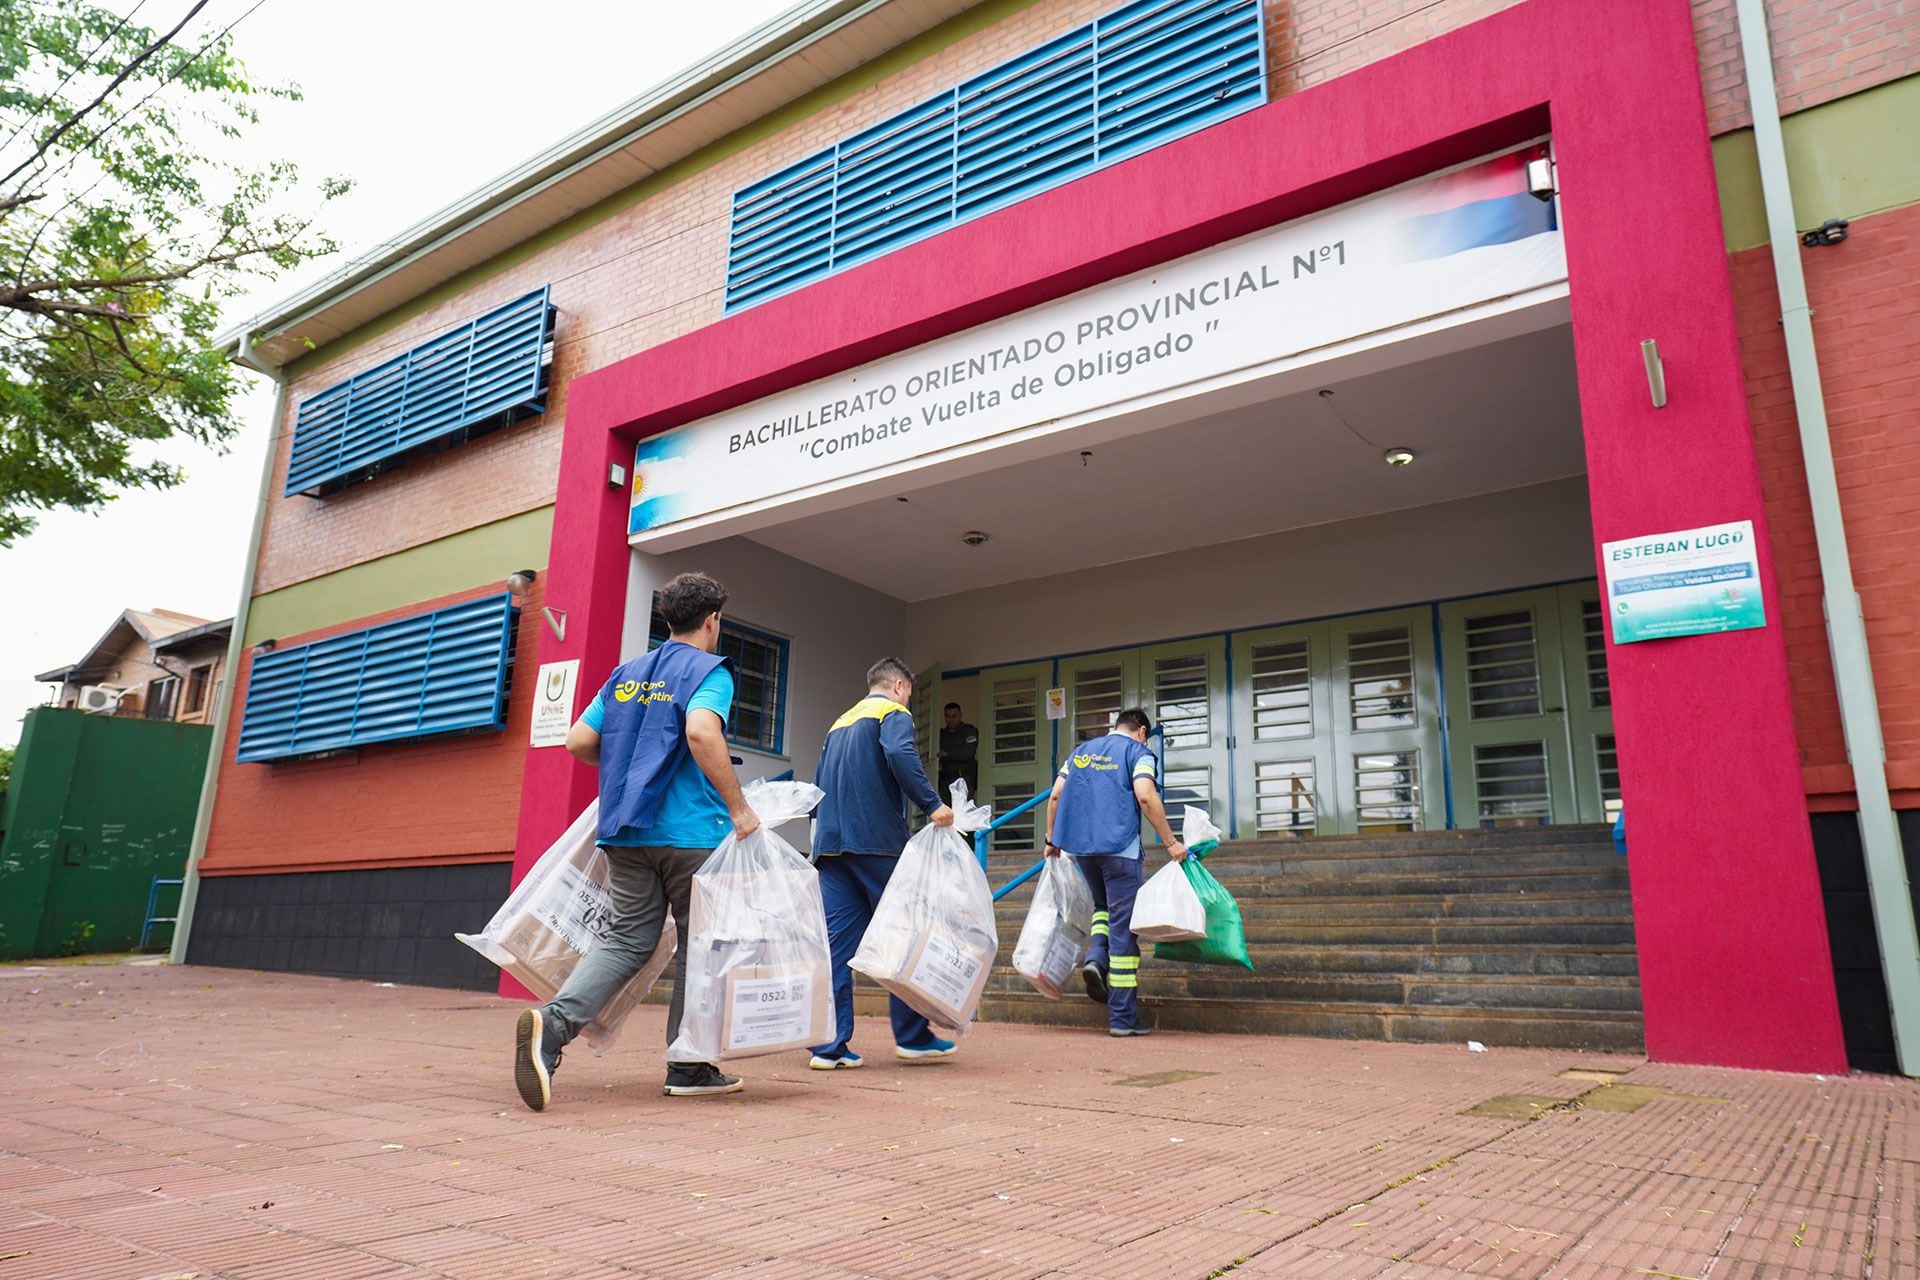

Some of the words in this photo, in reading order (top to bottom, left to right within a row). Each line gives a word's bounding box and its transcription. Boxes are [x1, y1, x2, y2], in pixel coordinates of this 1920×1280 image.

[729, 384, 897, 454] BACHILLERATO
[905, 330, 1066, 397] ORIENTADO
[1077, 265, 1280, 345] PROVINCIAL
[1293, 240, 1345, 280] Nº1
[921, 389, 1001, 427] Vuelta
[1010, 375, 1044, 400] de
[1054, 332, 1194, 388] Obligado
[1612, 540, 1689, 561] ESTEBAN
[1712, 570, 1747, 581] Nacional
[761, 991, 786, 1002] 0522
